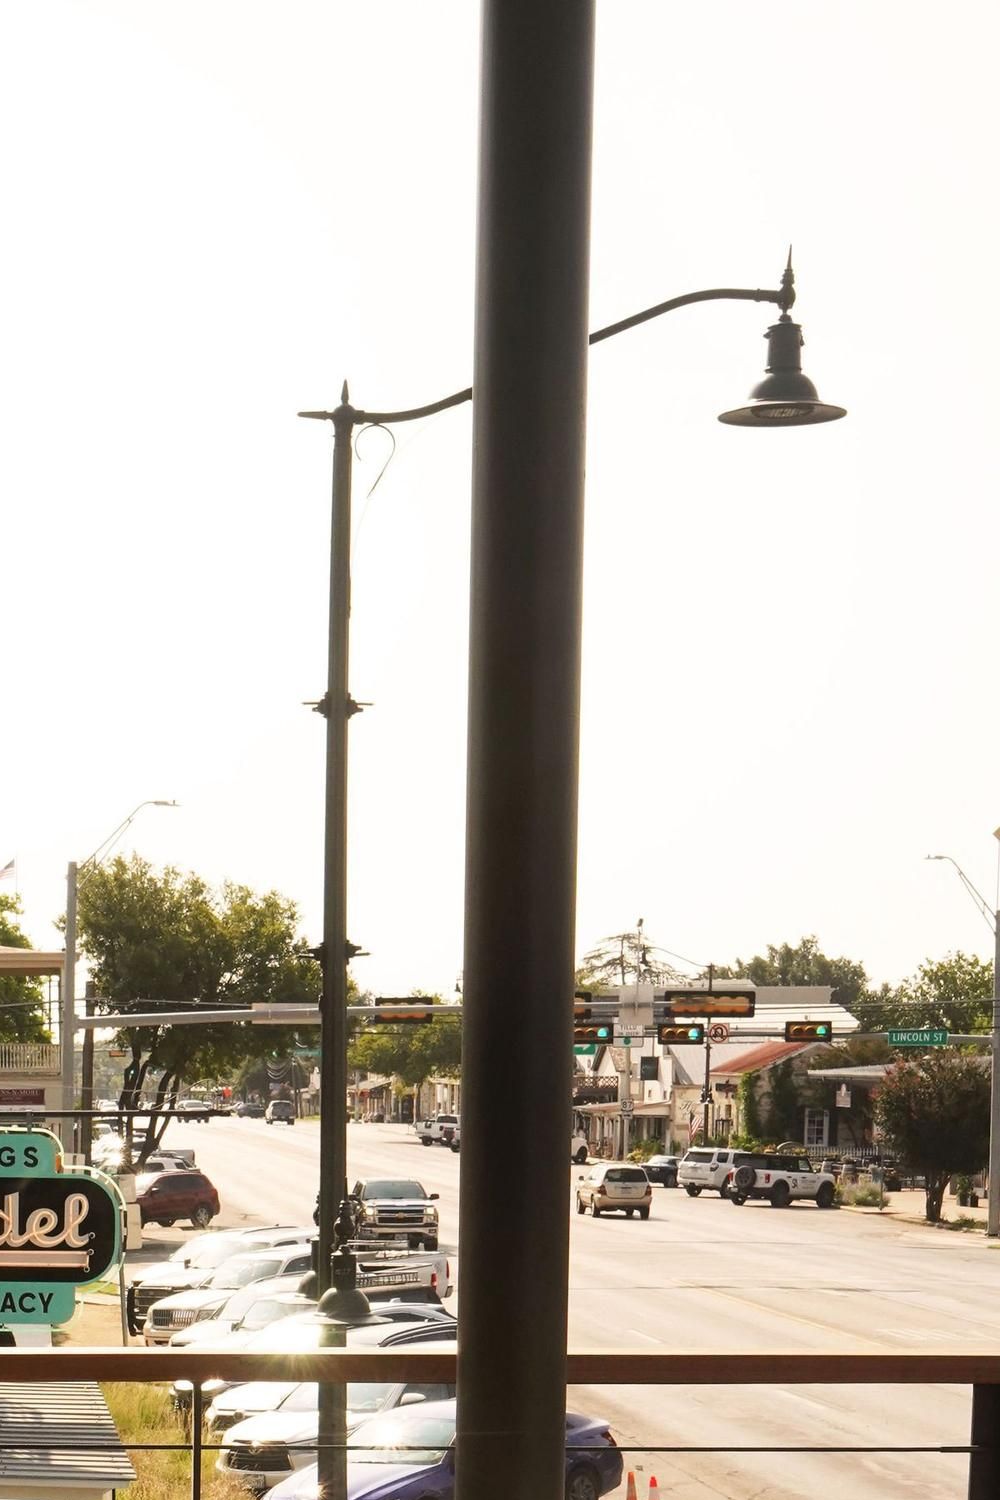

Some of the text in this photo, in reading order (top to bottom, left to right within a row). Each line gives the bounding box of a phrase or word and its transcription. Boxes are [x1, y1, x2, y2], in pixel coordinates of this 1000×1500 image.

[892, 1032, 943, 1042] LINCOLN ST
[622, 1100, 632, 1109] 87
